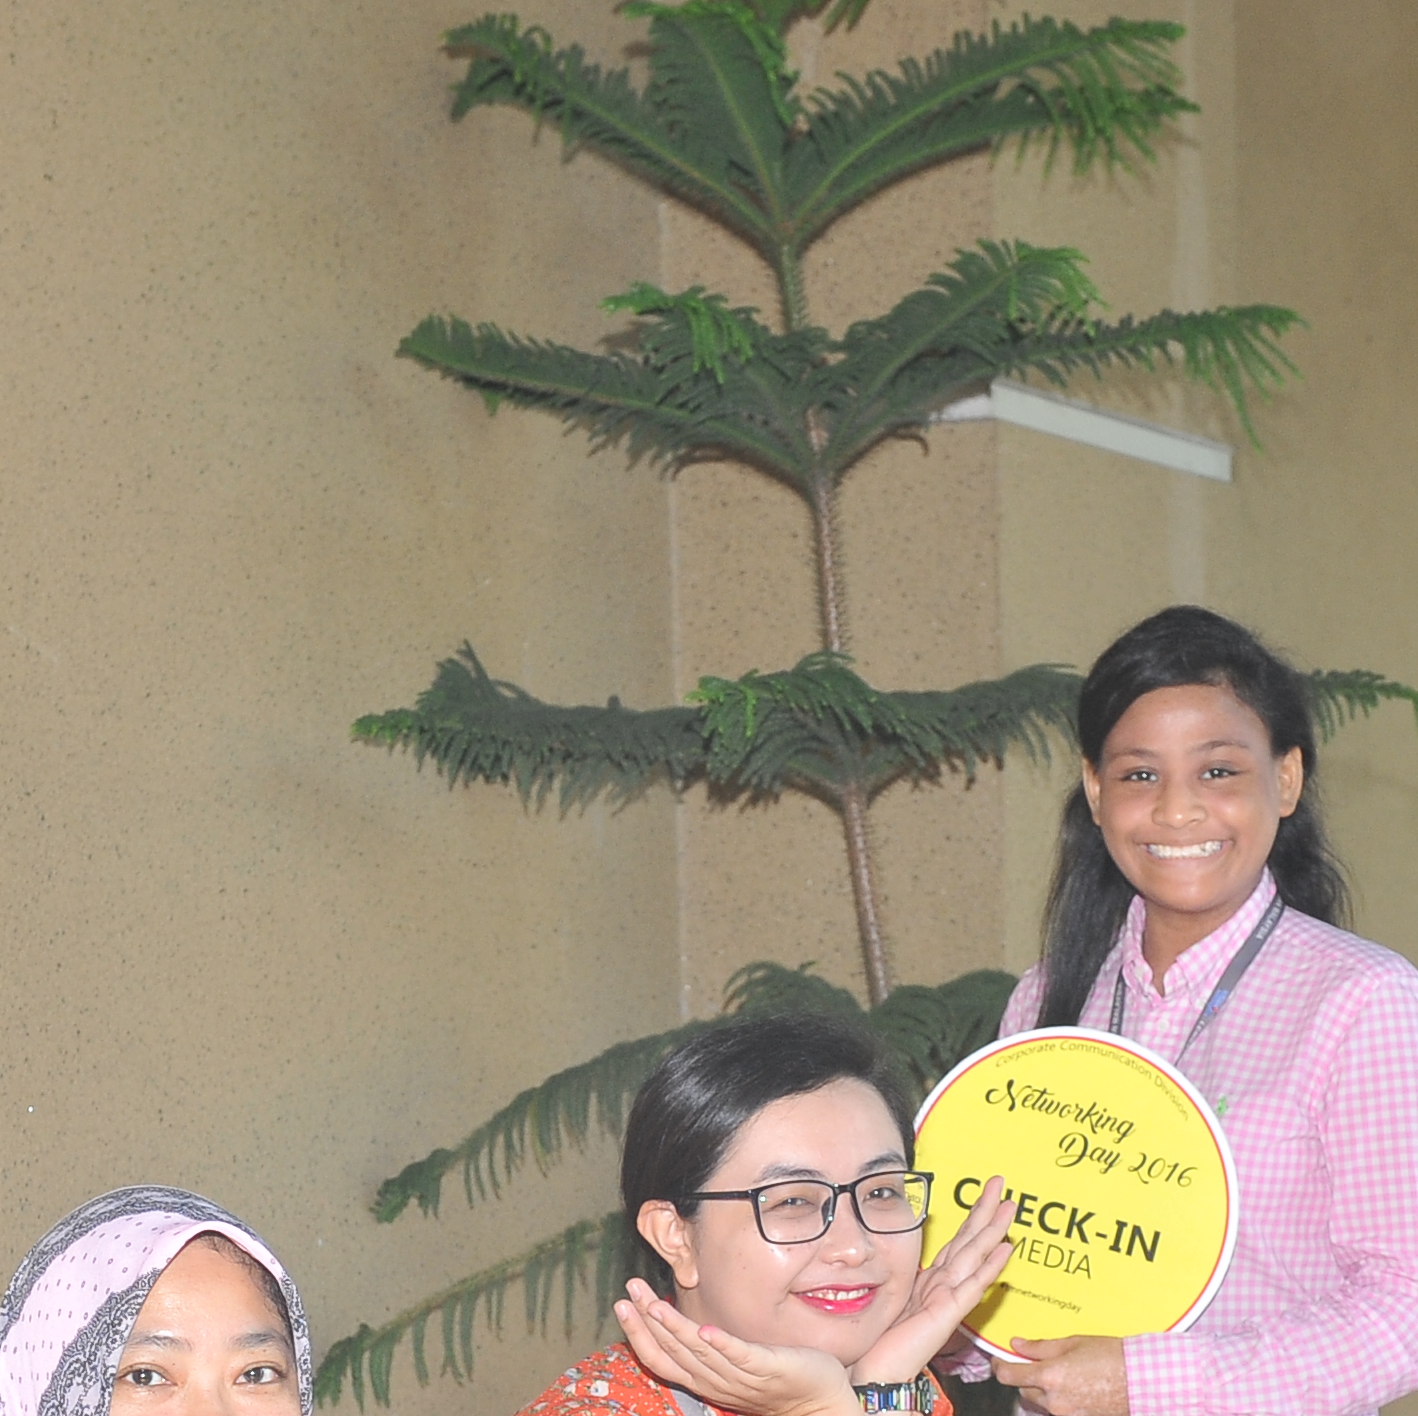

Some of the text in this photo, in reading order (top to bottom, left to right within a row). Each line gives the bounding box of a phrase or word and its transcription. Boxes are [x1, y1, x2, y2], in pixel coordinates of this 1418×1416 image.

[985, 1079, 1135, 1144] Networking
[995, 1040, 1189, 1121] Corporate Communication Division
[1055, 1132, 1198, 1188] Day 2016
